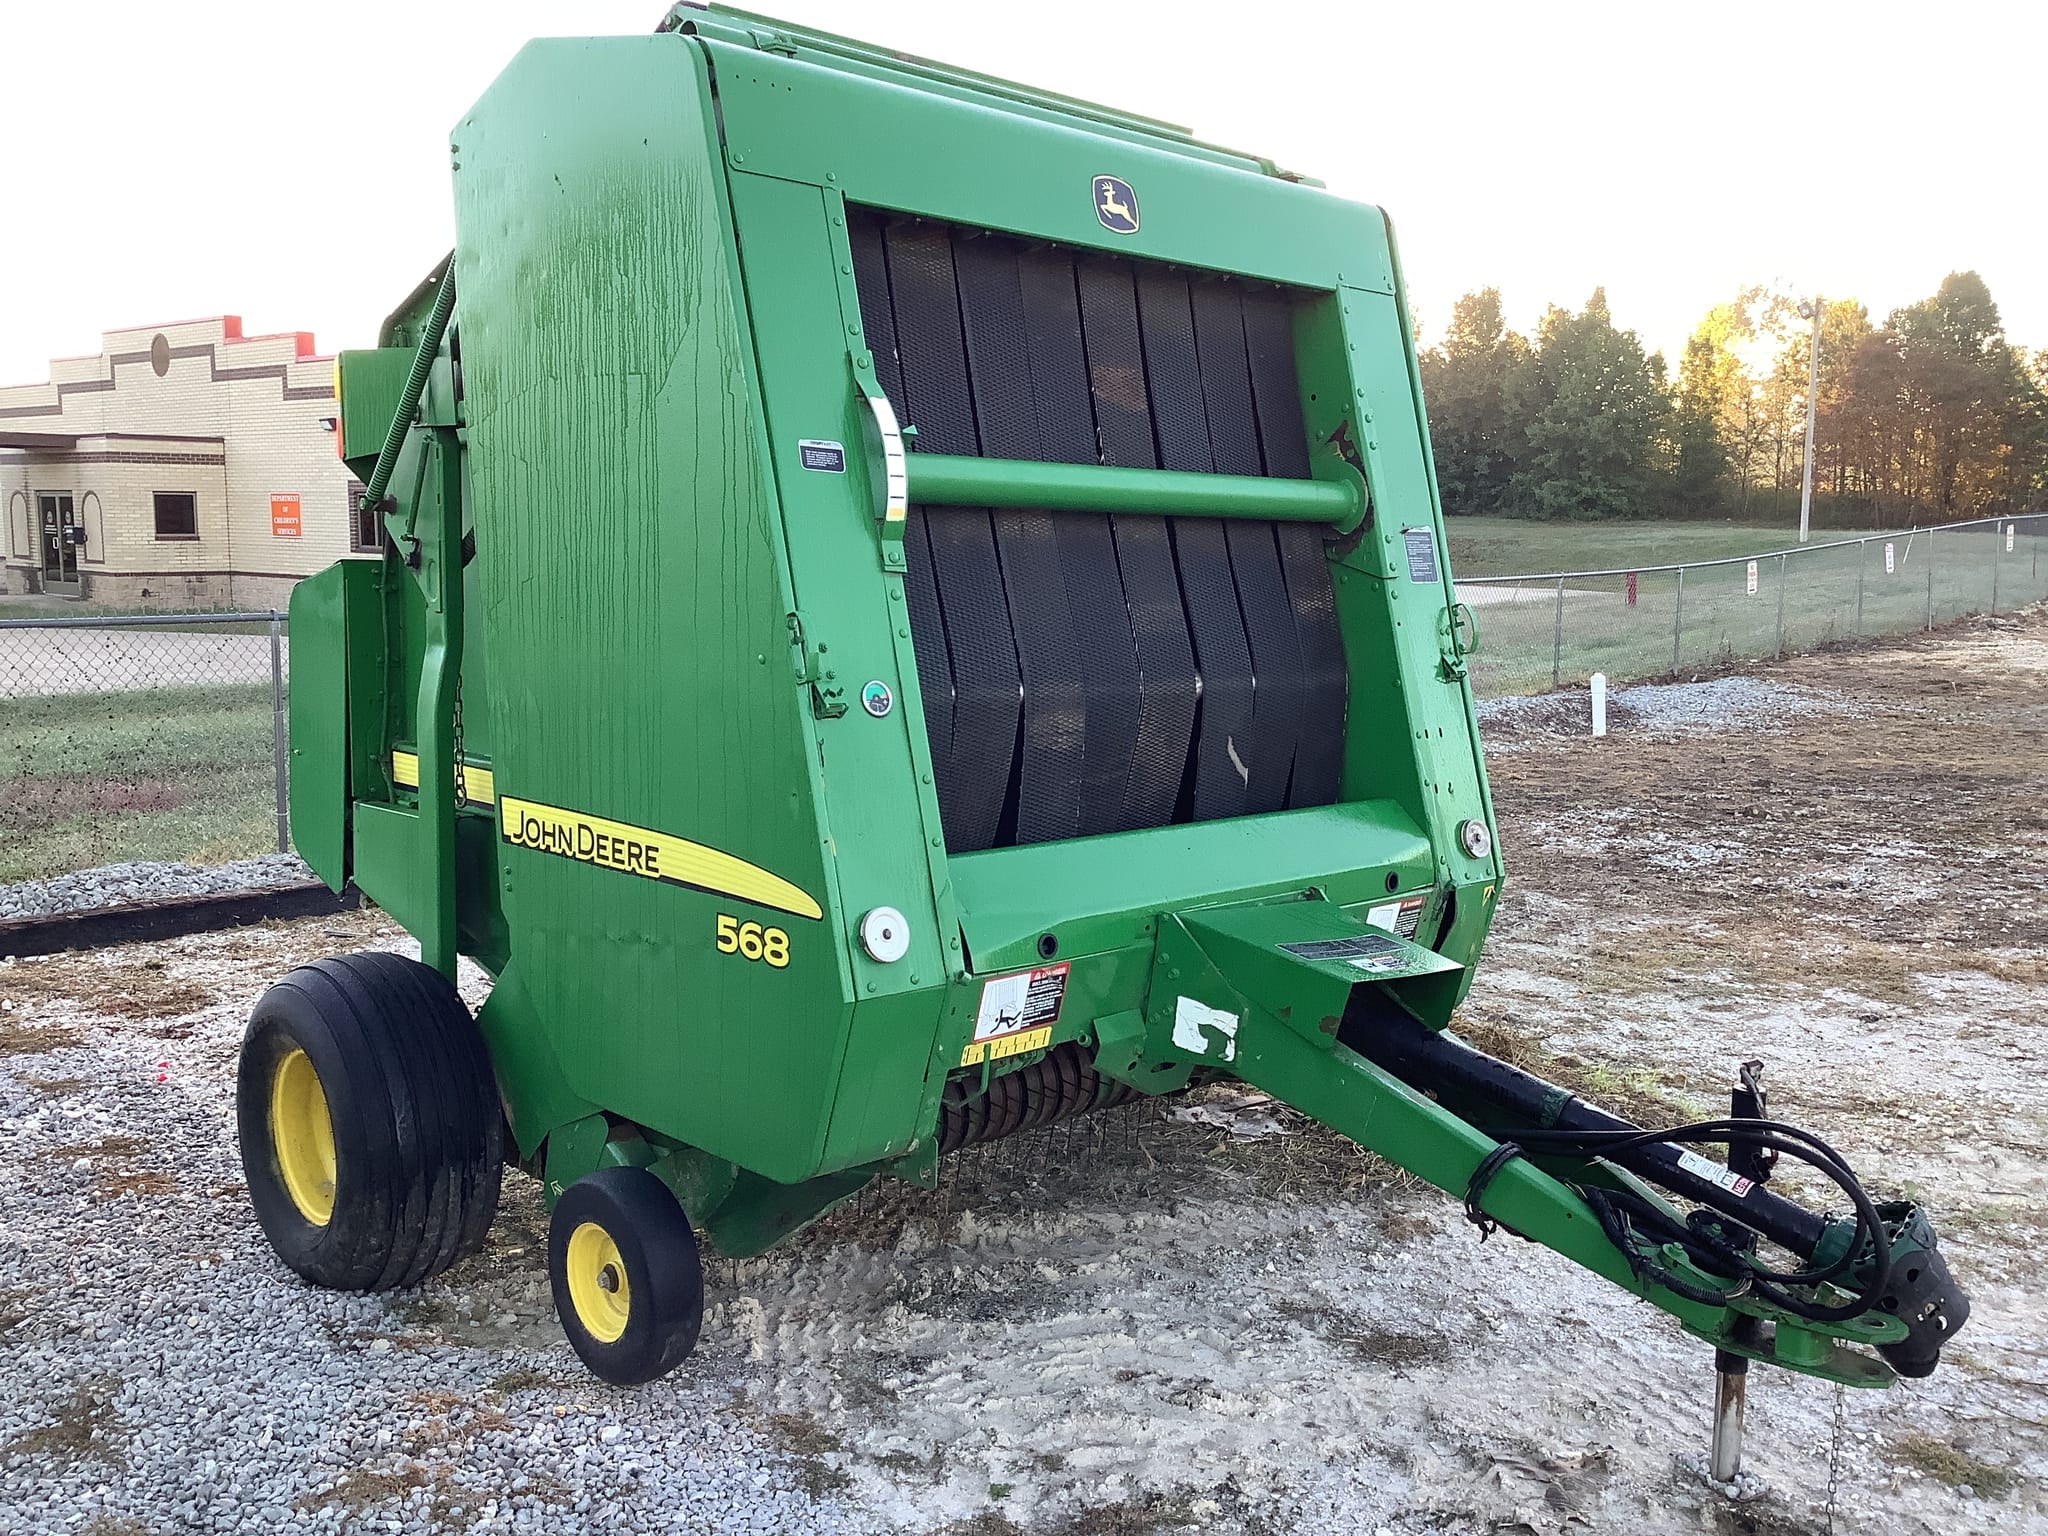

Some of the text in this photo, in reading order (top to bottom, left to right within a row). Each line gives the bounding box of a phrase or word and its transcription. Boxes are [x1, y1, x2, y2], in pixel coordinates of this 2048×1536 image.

[513, 809, 661, 875] JOHN DEERE
[716, 912, 790, 969] 568
